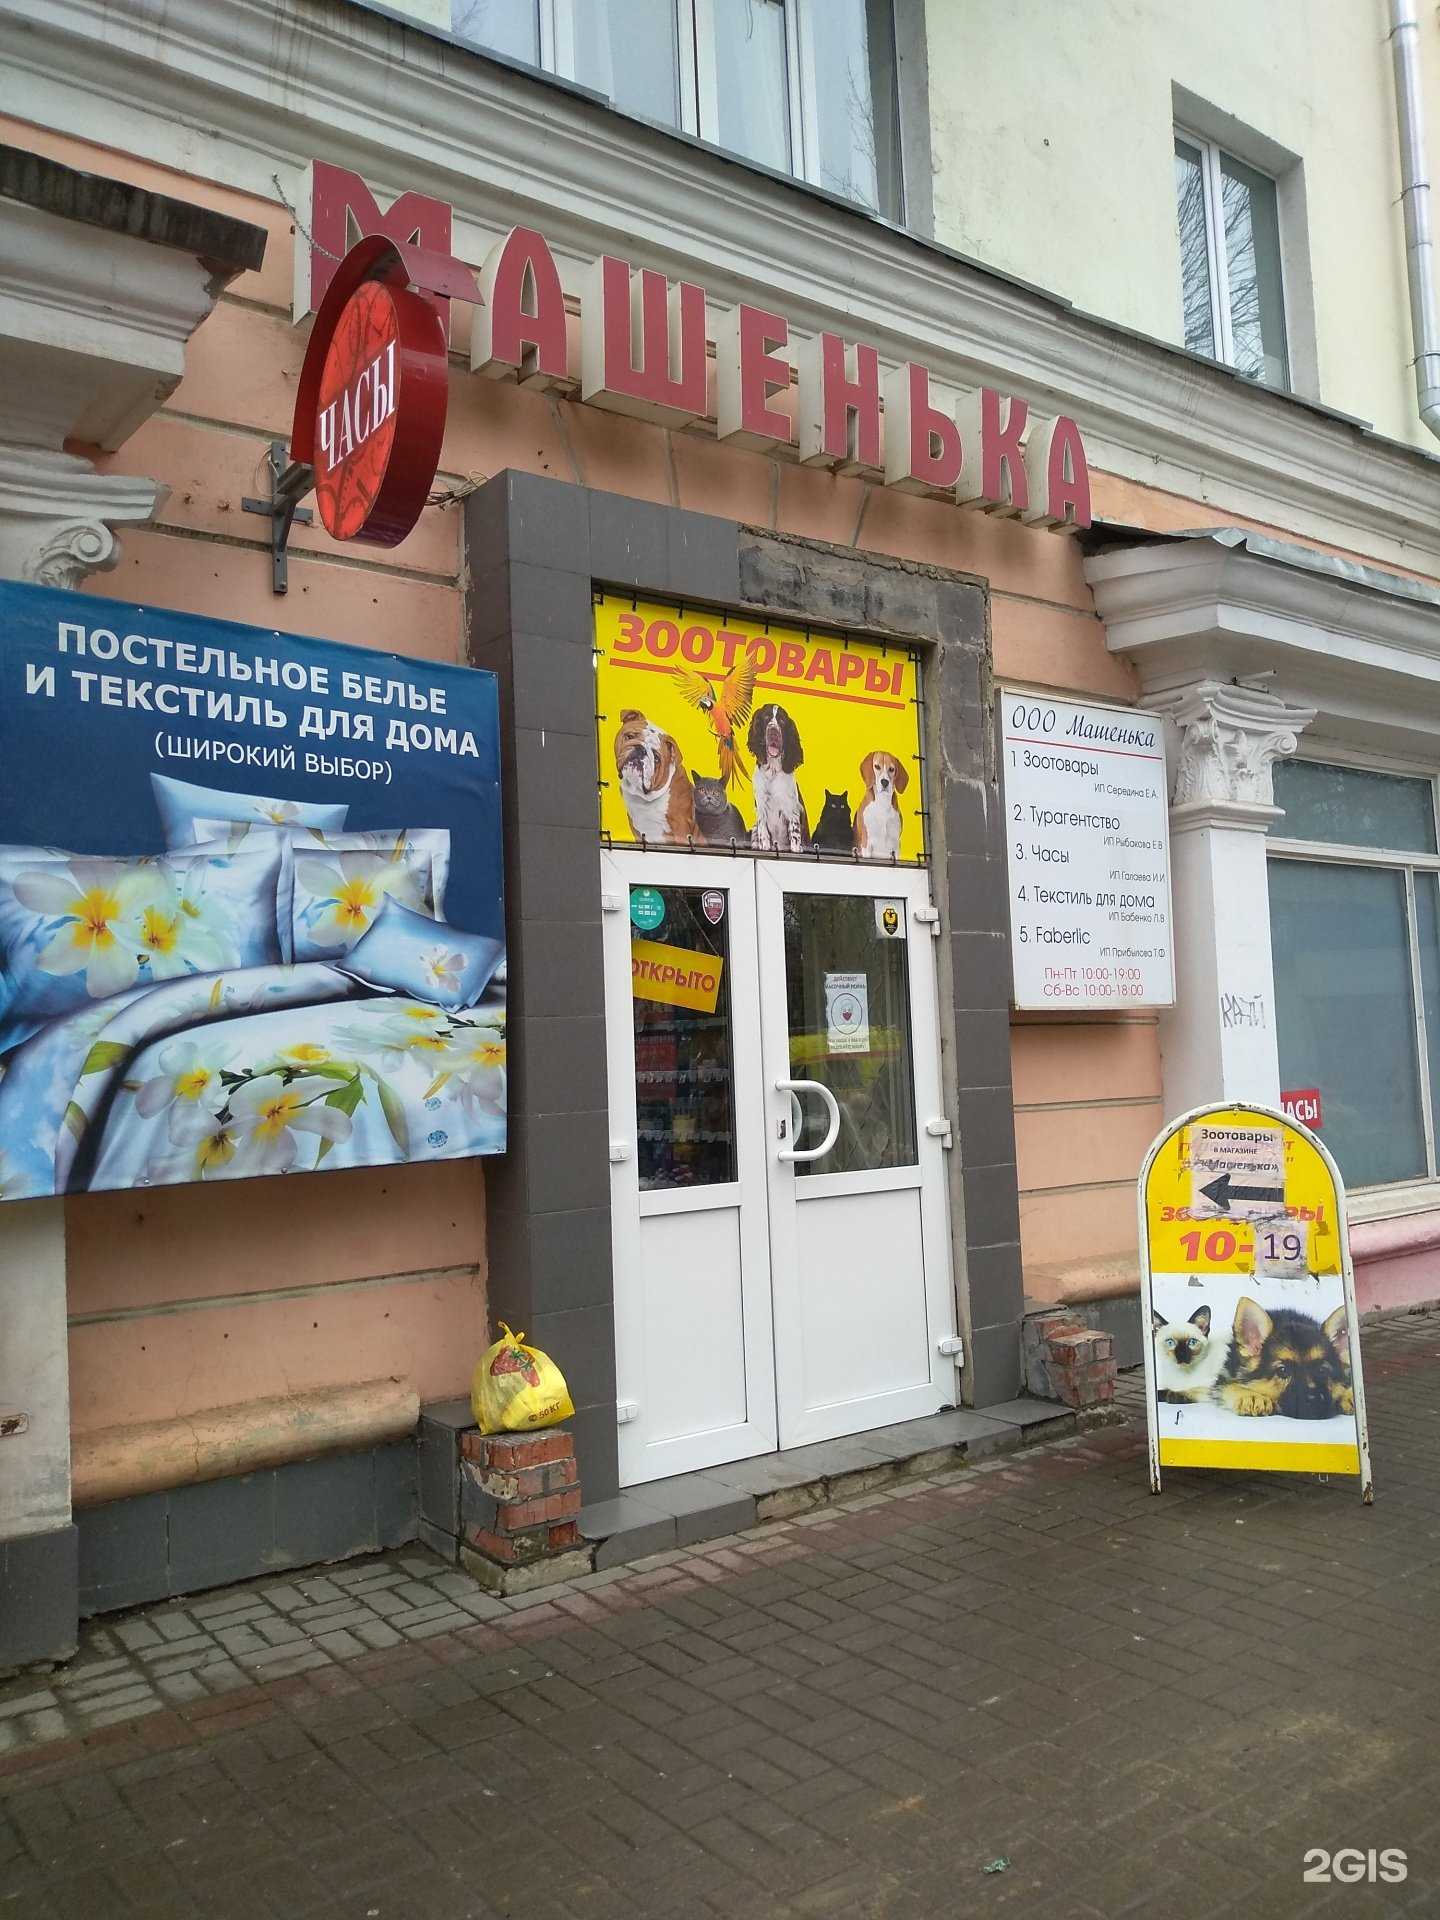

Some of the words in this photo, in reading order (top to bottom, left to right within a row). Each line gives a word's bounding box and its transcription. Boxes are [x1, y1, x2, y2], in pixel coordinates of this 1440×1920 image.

[311, 158, 1092, 530] МАШЕНЬКА
[319, 339, 396, 472] ЧАСЫ
[613, 612, 905, 696] ЗООТОВАРЫ
[58, 621, 329, 695] ПОСТЕЛЬНОЕ
[342, 671, 447, 715] БЕЛЬЕ
[26, 663, 55, 697] И
[71, 670, 288, 729] ТЕКСТИЛЬ
[299, 705, 374, 742] ДЛЯ
[385, 719, 480, 758] ДОМА
[1012, 705, 1056, 733] ООО
[1065, 715, 1156, 748] Машенька
[154, 730, 295, 770] (ШИРОКИЙ
[305, 753, 393, 785] ВЫБОР)
[1023, 750, 1099, 777] Зоотовары
[1094, 783, 1105, 793] ИП
[1013, 804, 1026, 821] 2.
[1029, 805, 1120, 830] Турагентство
[1015, 843, 1028, 860] 3.
[1031, 844, 1070, 864] Часы
[1103, 836, 1114, 846] ИП
[1115, 837, 1151, 849] Рыбакова
[1109, 870, 1120, 880] ИП
[1017, 885, 1030, 902] 4.
[1034, 886, 1092, 905] Текстиль
[1095, 893, 1116, 907] для
[1119, 894, 1155, 909] дома
[1108, 912, 1120, 921] ИП
[1120, 912, 1152, 923] Бабенко
[1019, 925, 1032, 943] 5.
[1036, 926, 1091, 945] Faberlic
[1099, 947, 1111, 957] ИП
[631, 958, 716, 993] ОТКРЫТО
[1044, 967, 1077, 980] Пн-Пт
[1081, 967, 1141, 980] 10:00-19:00
[1043, 984, 1080, 997] Сб-Вс
[1084, 984, 1144, 997] 10:00-18:00
[1201, 1129, 1273, 1143] Зоотовары
[1220, 1146, 1258, 1154] МАГАЗИНЕ
